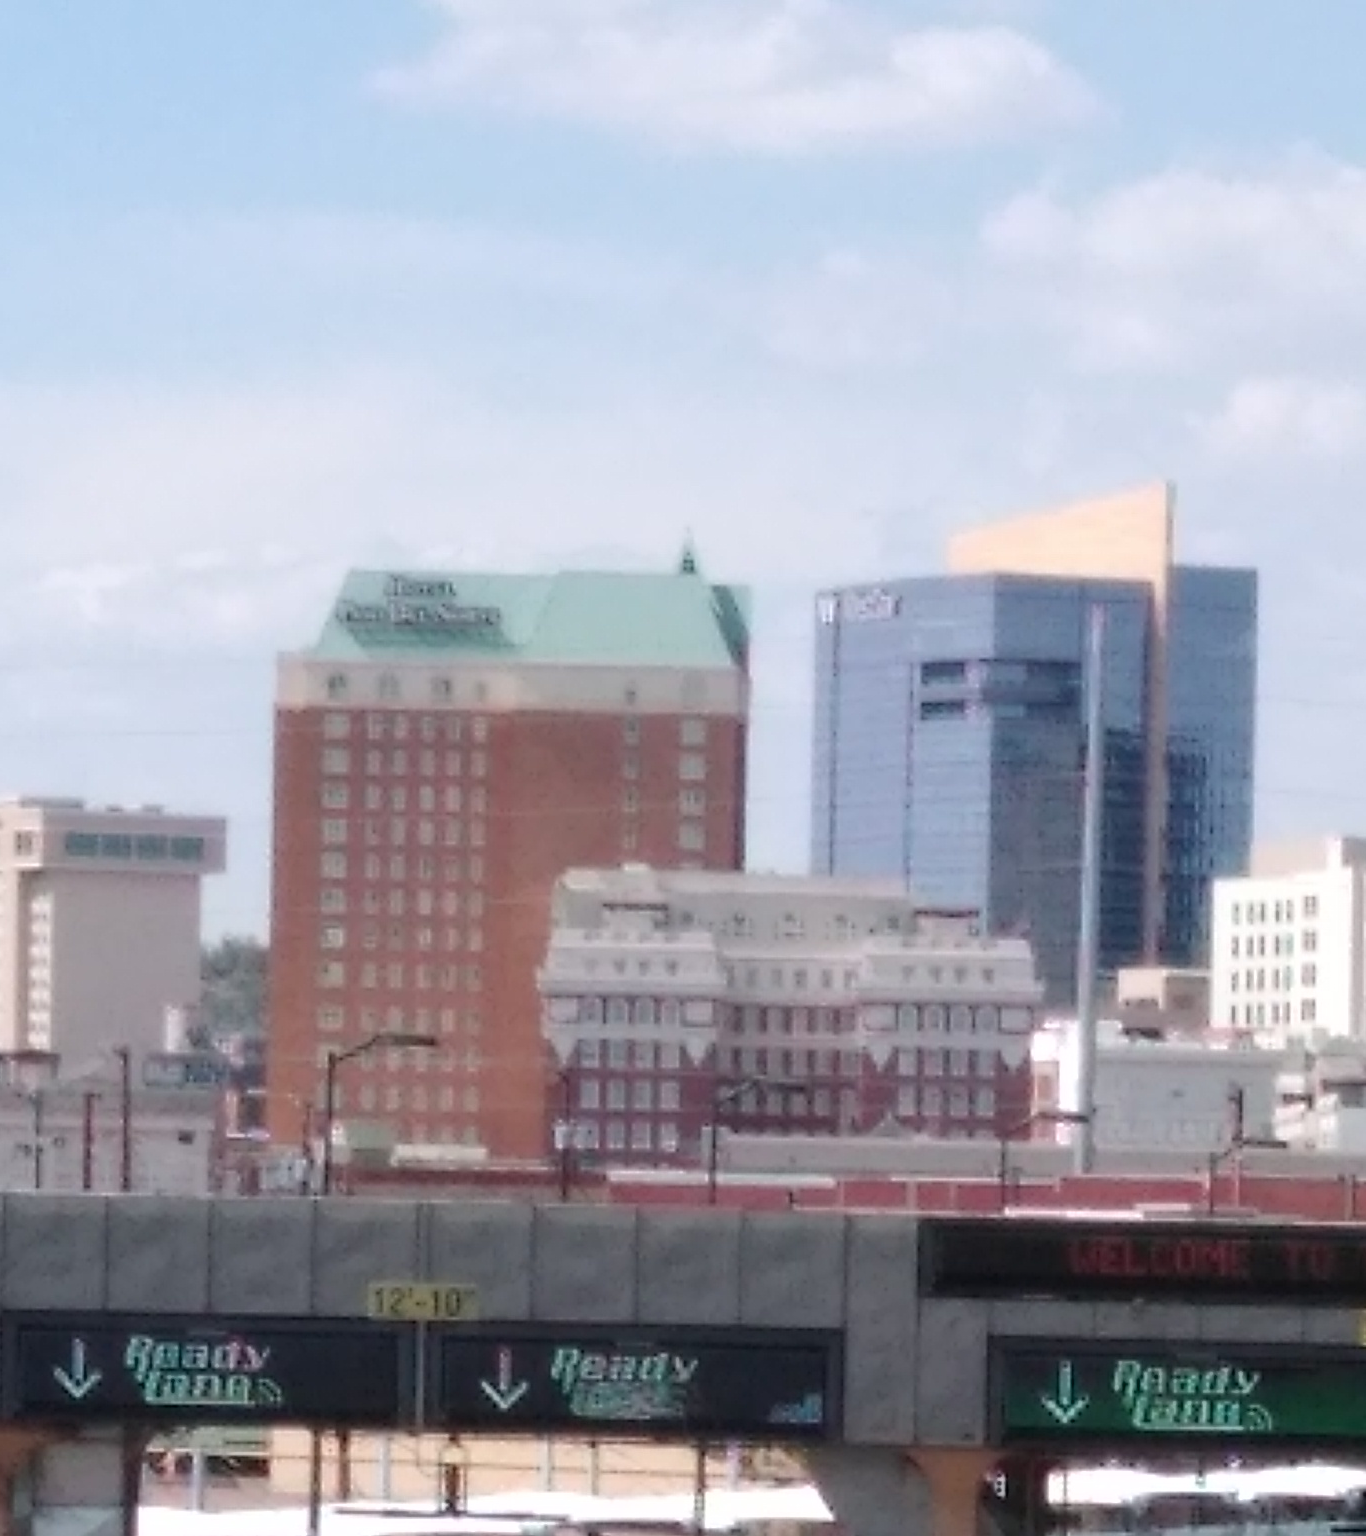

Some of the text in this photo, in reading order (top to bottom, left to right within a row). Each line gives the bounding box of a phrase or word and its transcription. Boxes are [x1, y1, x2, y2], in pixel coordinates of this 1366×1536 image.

[1067, 1238, 1251, 1278] WELCOME
[1283, 1243, 1332, 1280] TO
[124, 1334, 270, 1384] Ready
[550, 1348, 698, 1394] Ready
[1112, 1360, 1261, 1408] Ready
